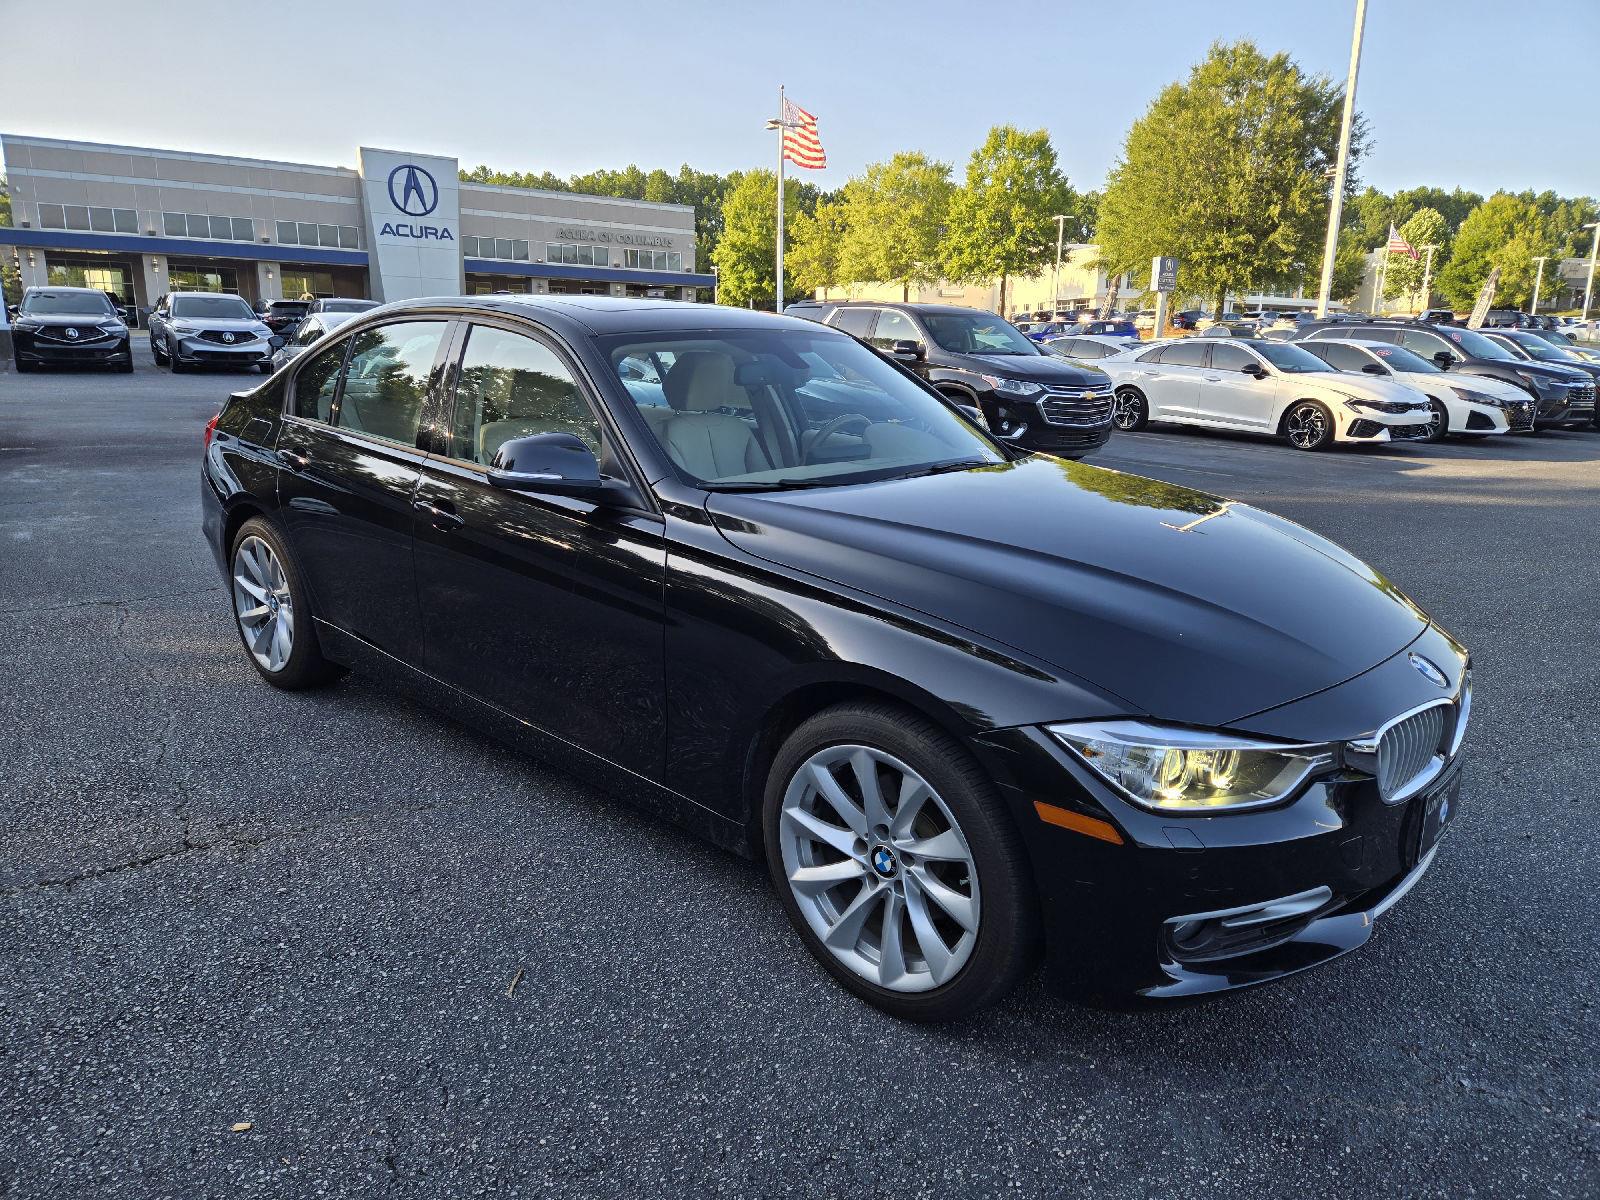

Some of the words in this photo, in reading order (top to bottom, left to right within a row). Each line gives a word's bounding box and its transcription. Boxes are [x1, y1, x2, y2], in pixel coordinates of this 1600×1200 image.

[379, 222, 454, 241] ACURA
[555, 227, 596, 242] ACURA
[616, 233, 673, 248] COLUMBUS
